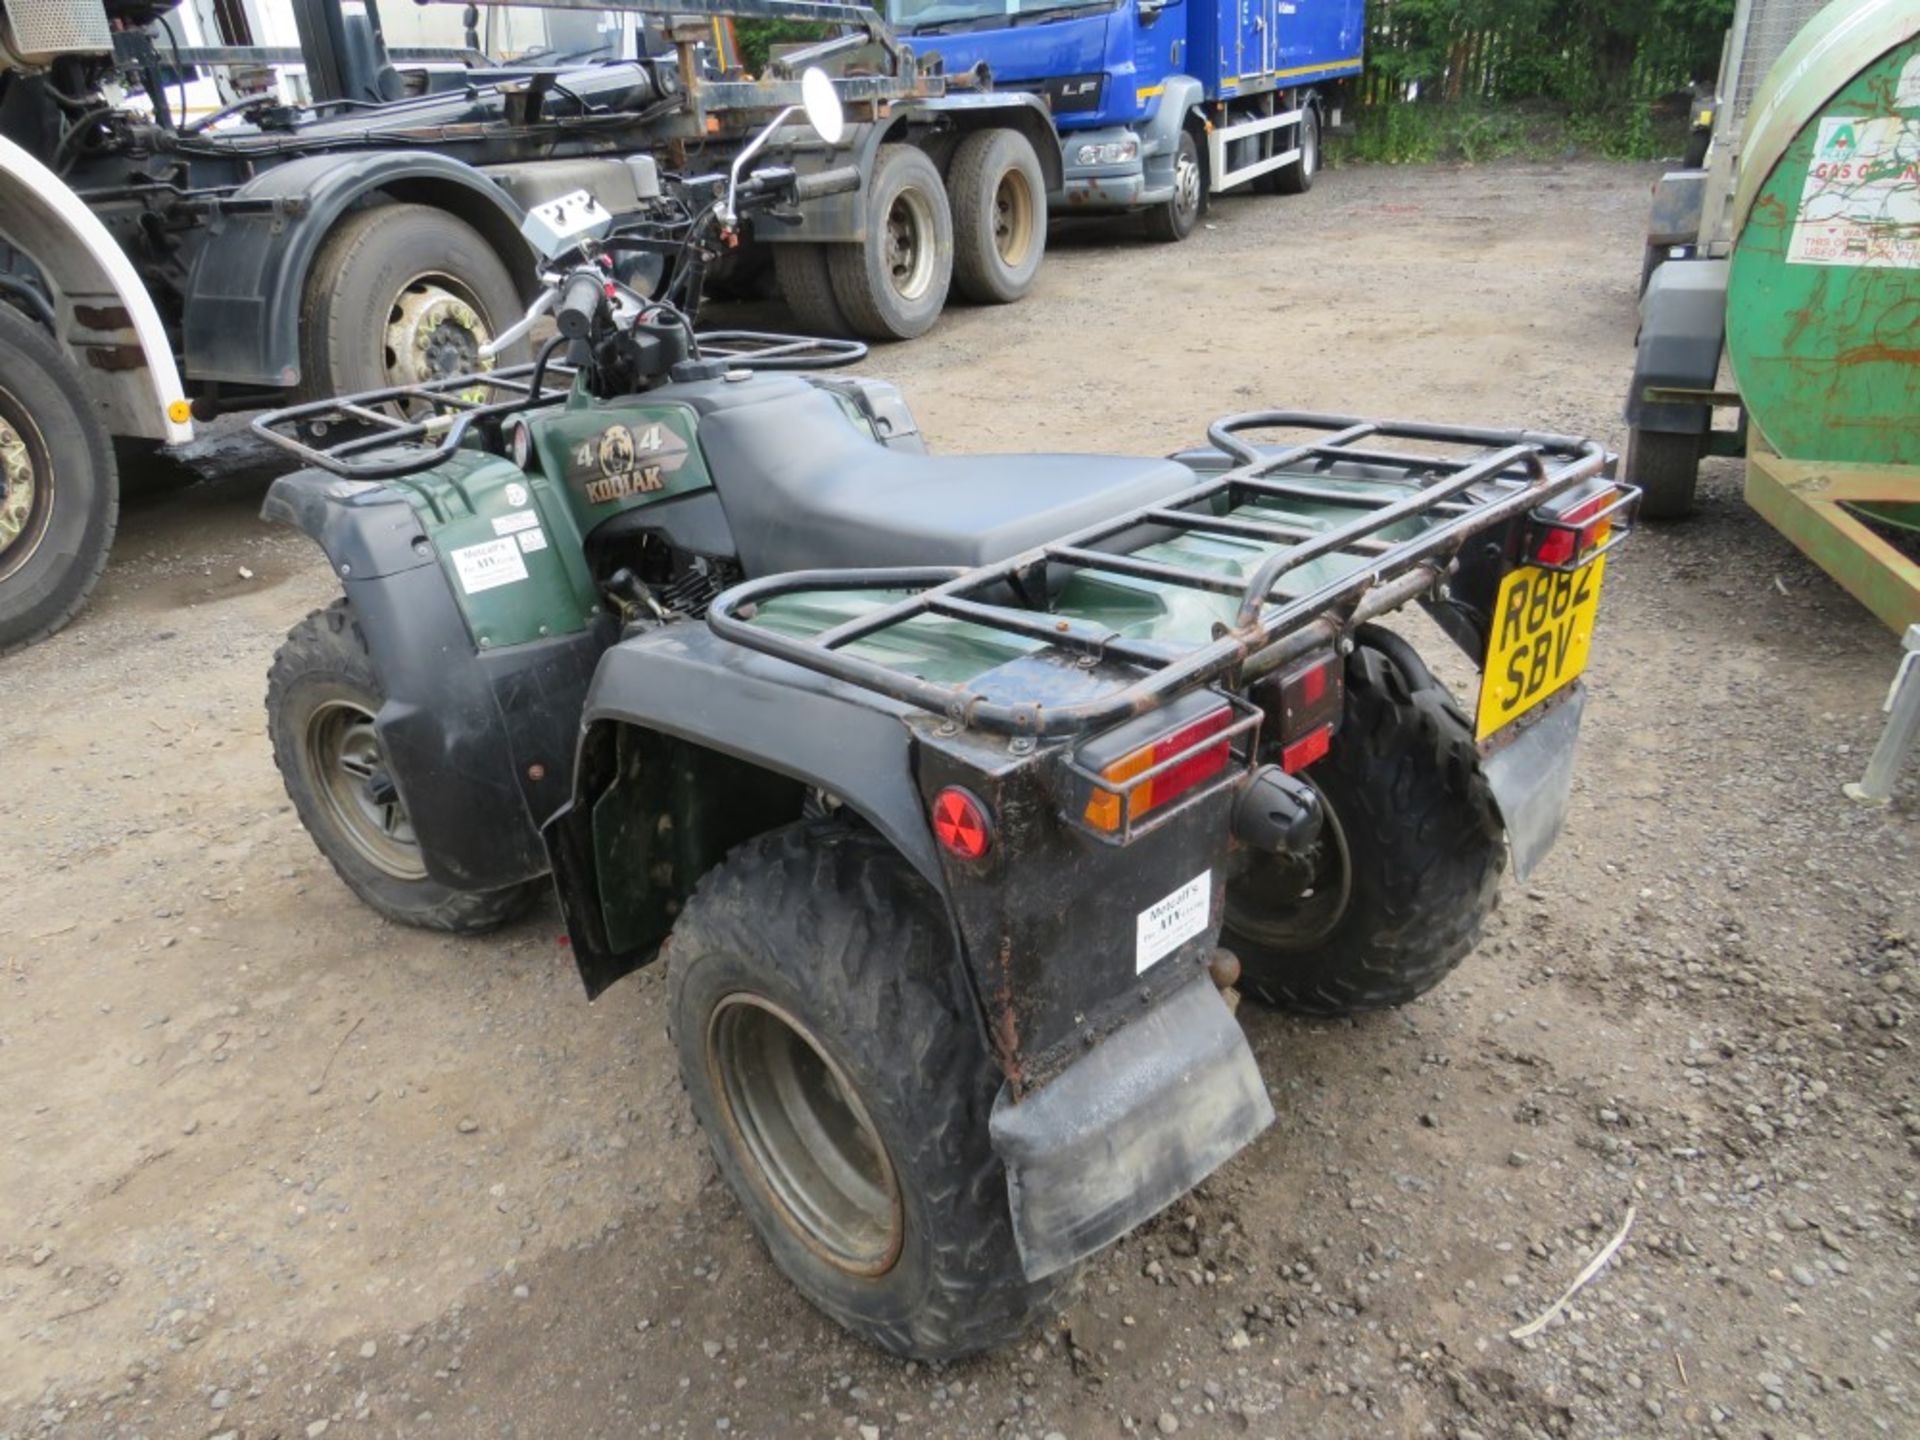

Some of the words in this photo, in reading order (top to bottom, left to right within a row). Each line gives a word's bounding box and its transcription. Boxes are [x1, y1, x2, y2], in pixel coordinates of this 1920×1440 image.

[1061, 81, 1097, 96] LF
[1815, 162, 1851, 179] GAS
[577, 443, 594, 467] 4
[639, 426, 663, 450] 4
[585, 466, 663, 504] KODIAK
[1499, 566, 1592, 653] R882
[1501, 613, 1576, 711] SBV
